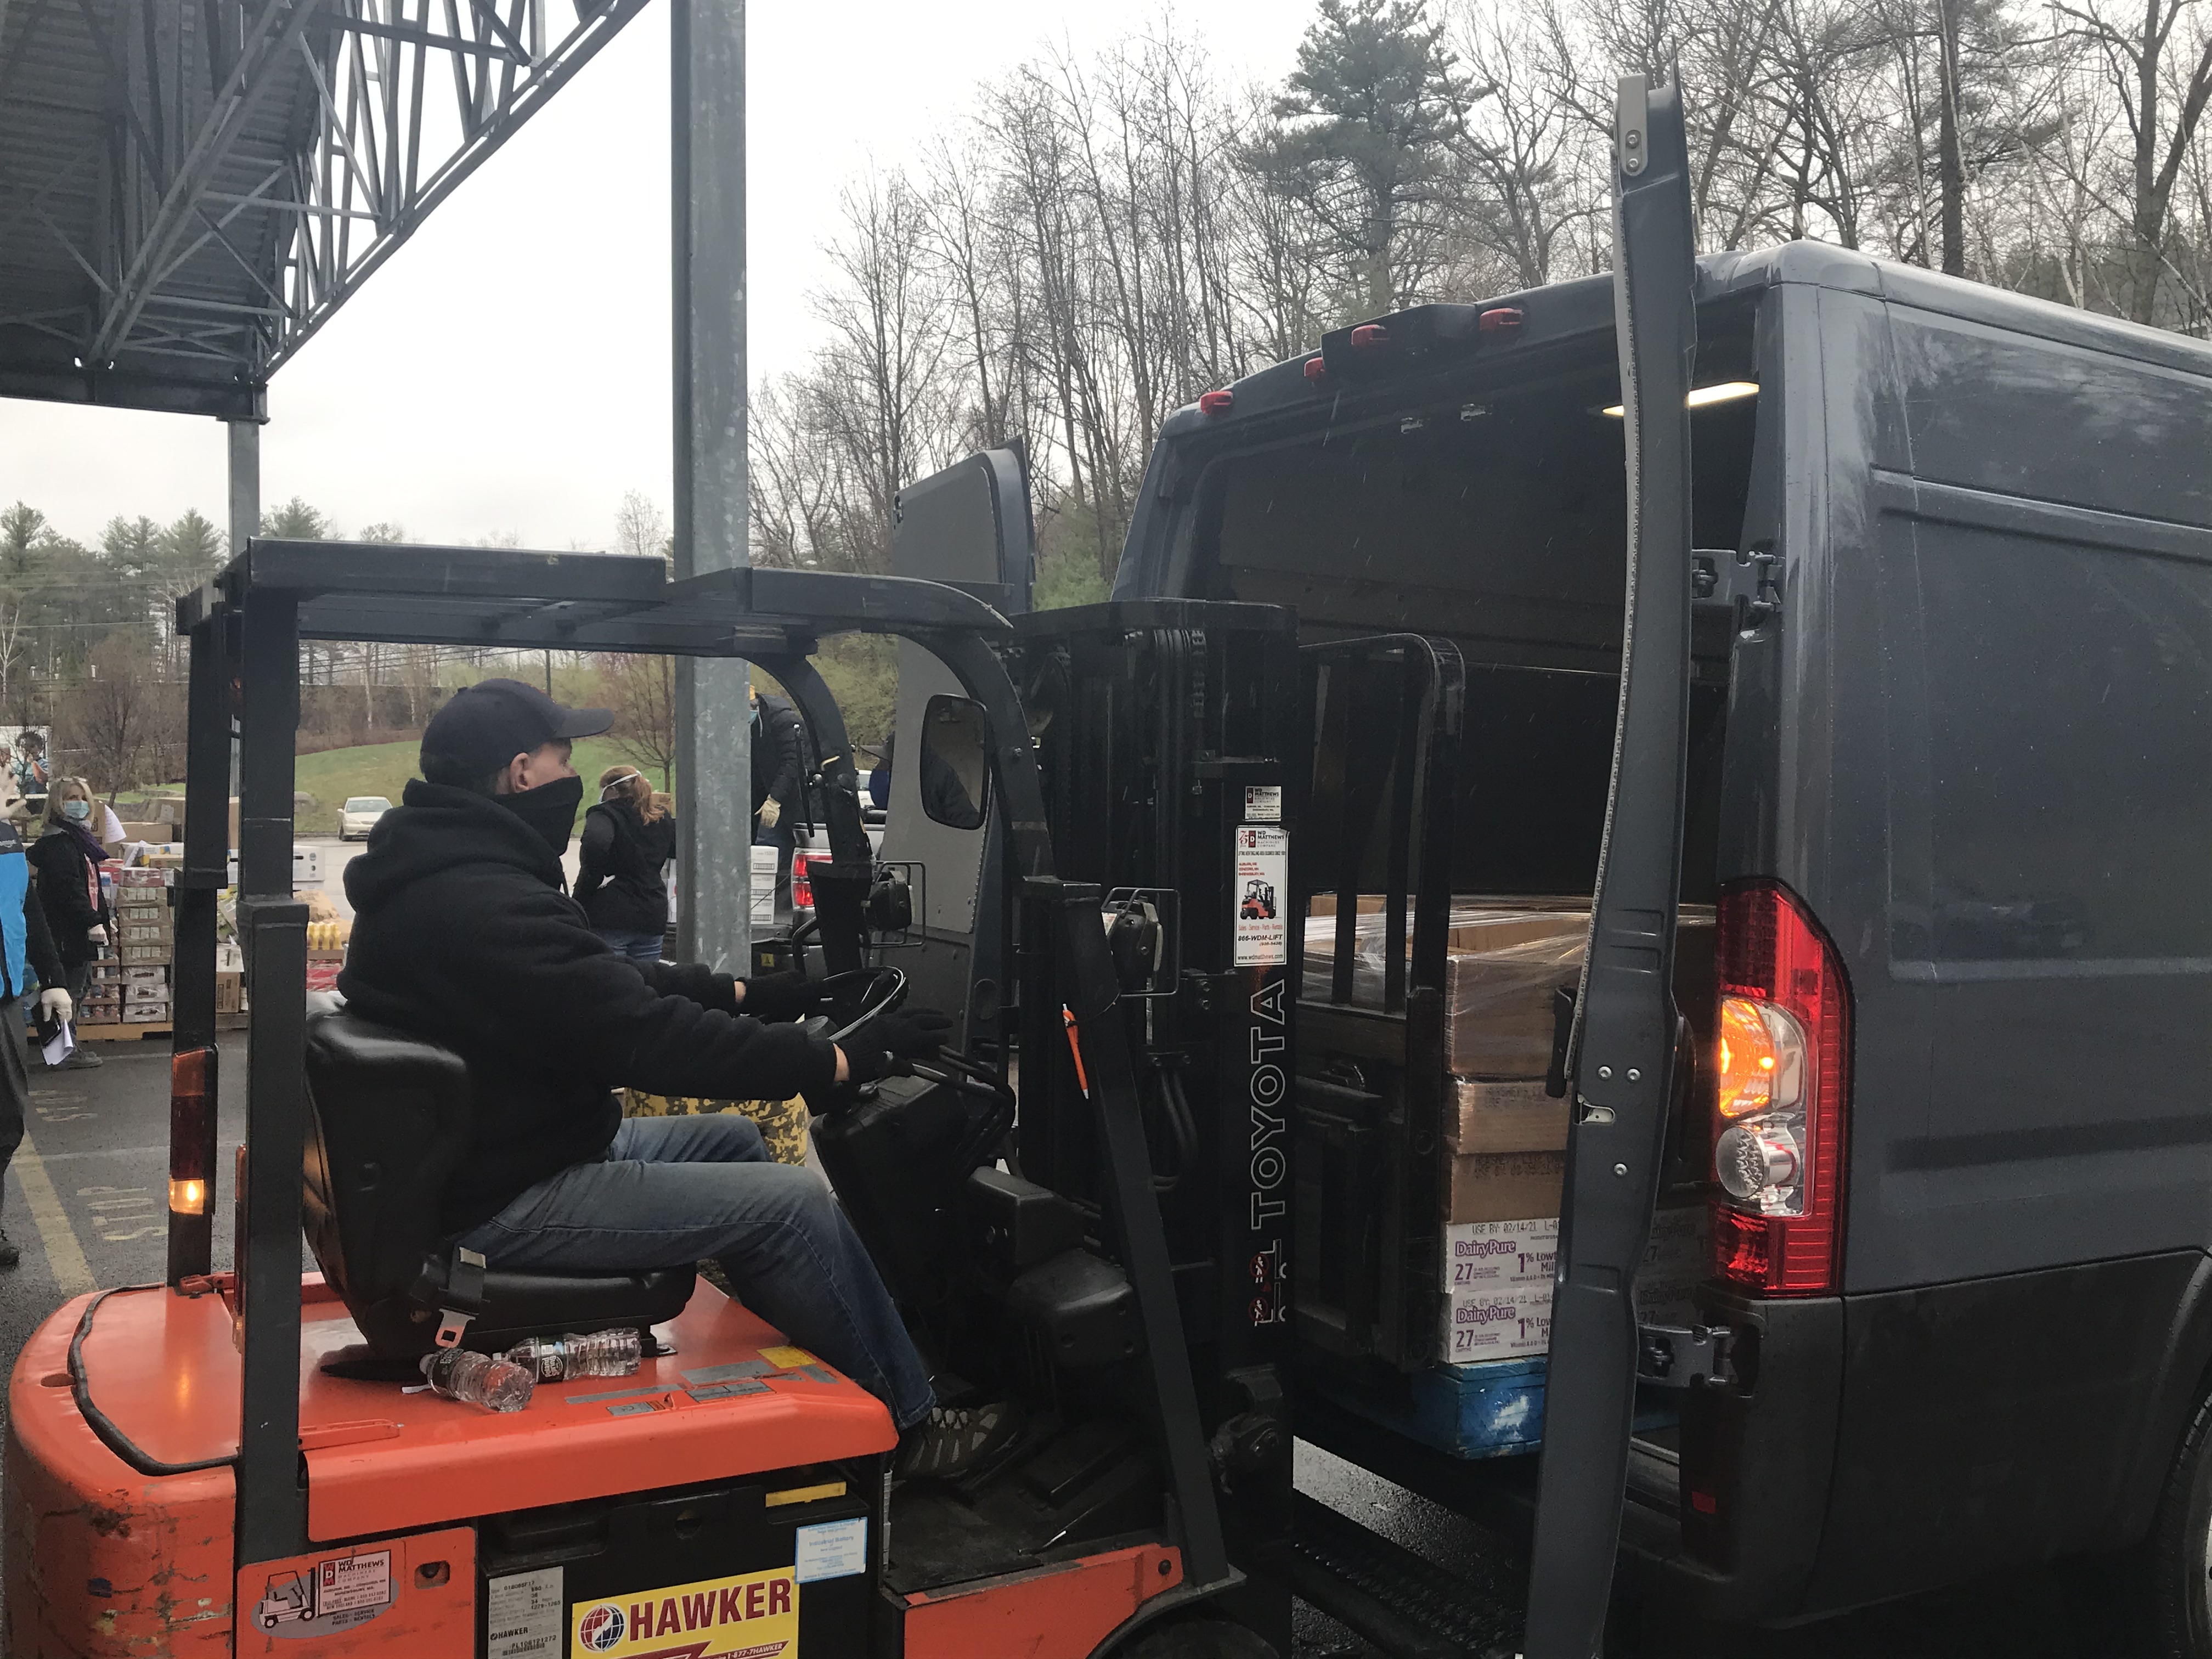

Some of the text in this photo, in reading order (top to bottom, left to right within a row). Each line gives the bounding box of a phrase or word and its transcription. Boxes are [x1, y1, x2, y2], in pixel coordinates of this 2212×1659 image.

[1250, 979, 1285, 1229] TOYOTA
[1503, 1221, 1537, 1233] 02/14/21
[1455, 1239, 1516, 1259] DairyPure
[1455, 1263, 1474, 1281] 27
[1517, 1252, 1534, 1273] 1%
[1457, 1305, 1516, 1325] DairyPure
[1517, 1317, 1534, 1339] 1%
[1456, 1329, 1475, 1348] 27
[338, 1559, 384, 1573] MATTHEWS
[630, 1578, 791, 1641] HAWKER
[498, 1627, 528, 1639] HAWKER
[727, 1643, 783, 1658] 1-877-7HAWKER
